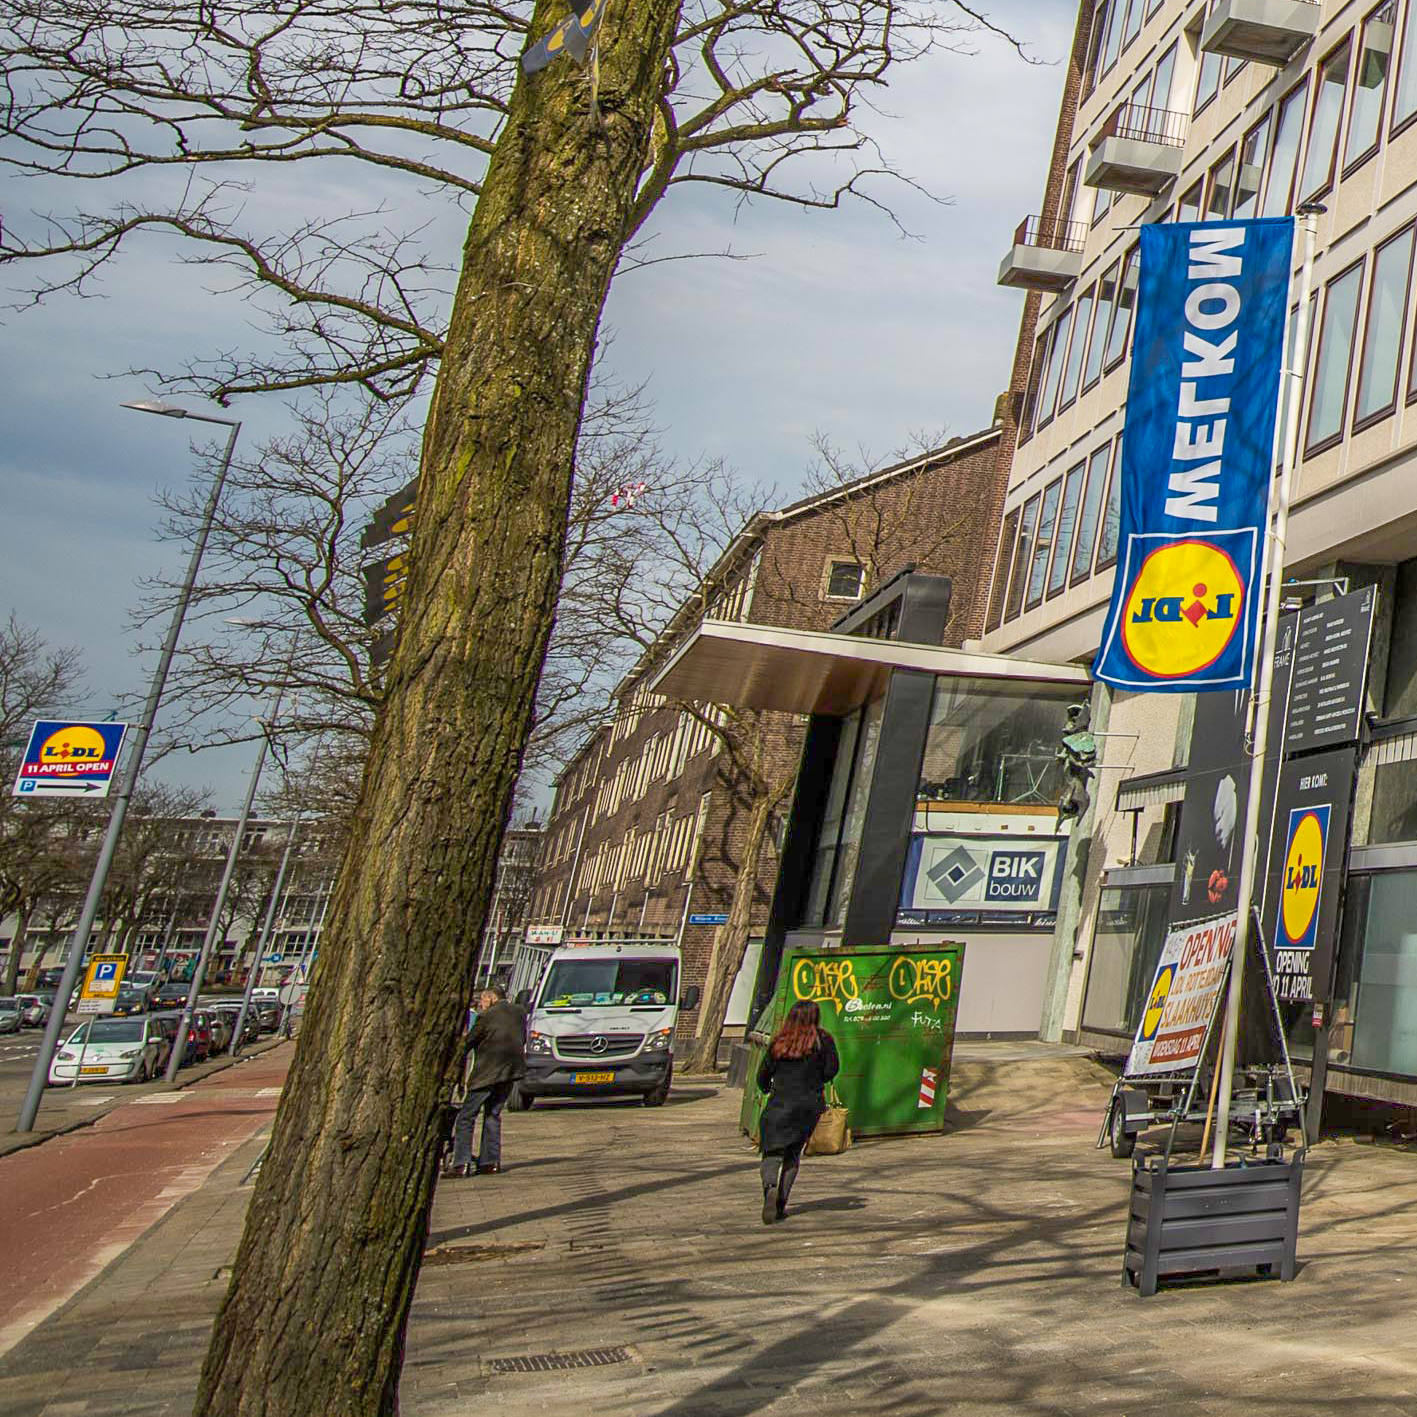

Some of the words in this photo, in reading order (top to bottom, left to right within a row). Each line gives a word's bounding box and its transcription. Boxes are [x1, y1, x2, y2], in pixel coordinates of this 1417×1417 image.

[28, 765, 38, 773] 11
[39, 763, 75, 773] APRIL
[76, 762, 109, 771] OPEN
[1300, 776, 1312, 791] HIER
[992, 857, 1039, 878] BIK
[989, 881, 1037, 896] bouw
[1276, 951, 1310, 974] OPENING
[1280, 976, 1289, 998] 11
[1289, 976, 1313, 999] APRIL
